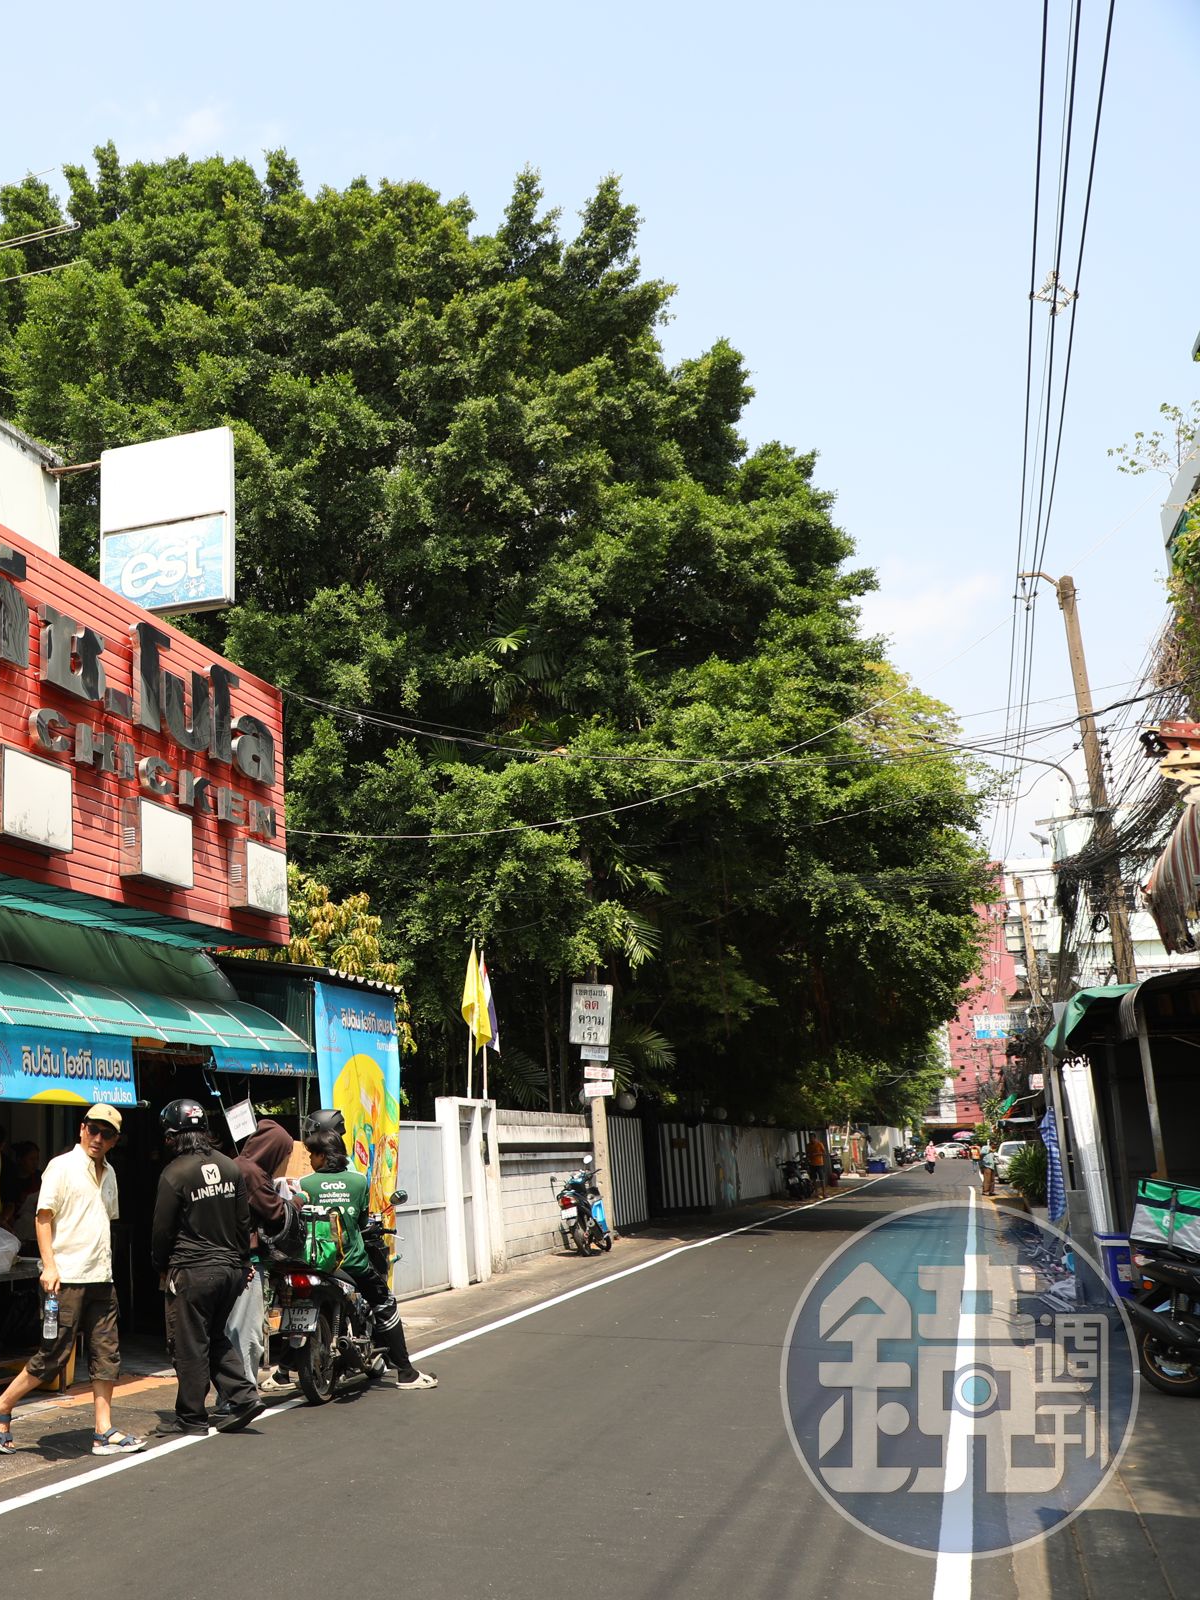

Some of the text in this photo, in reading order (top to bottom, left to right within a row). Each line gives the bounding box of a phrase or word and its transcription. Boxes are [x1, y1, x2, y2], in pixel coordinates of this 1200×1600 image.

[121, 537, 204, 599] est
[29, 708, 276, 840] CHICKEN
[584, 1000, 599, 1010] ลด
[578, 1015, 605, 1026] ความ
[582, 1027, 598, 1041] เร็ว
[21, 1045, 131, 1082] ลิปตัน ไอซ์ที เลมอน
[320, 1181, 346, 1190] Grab
